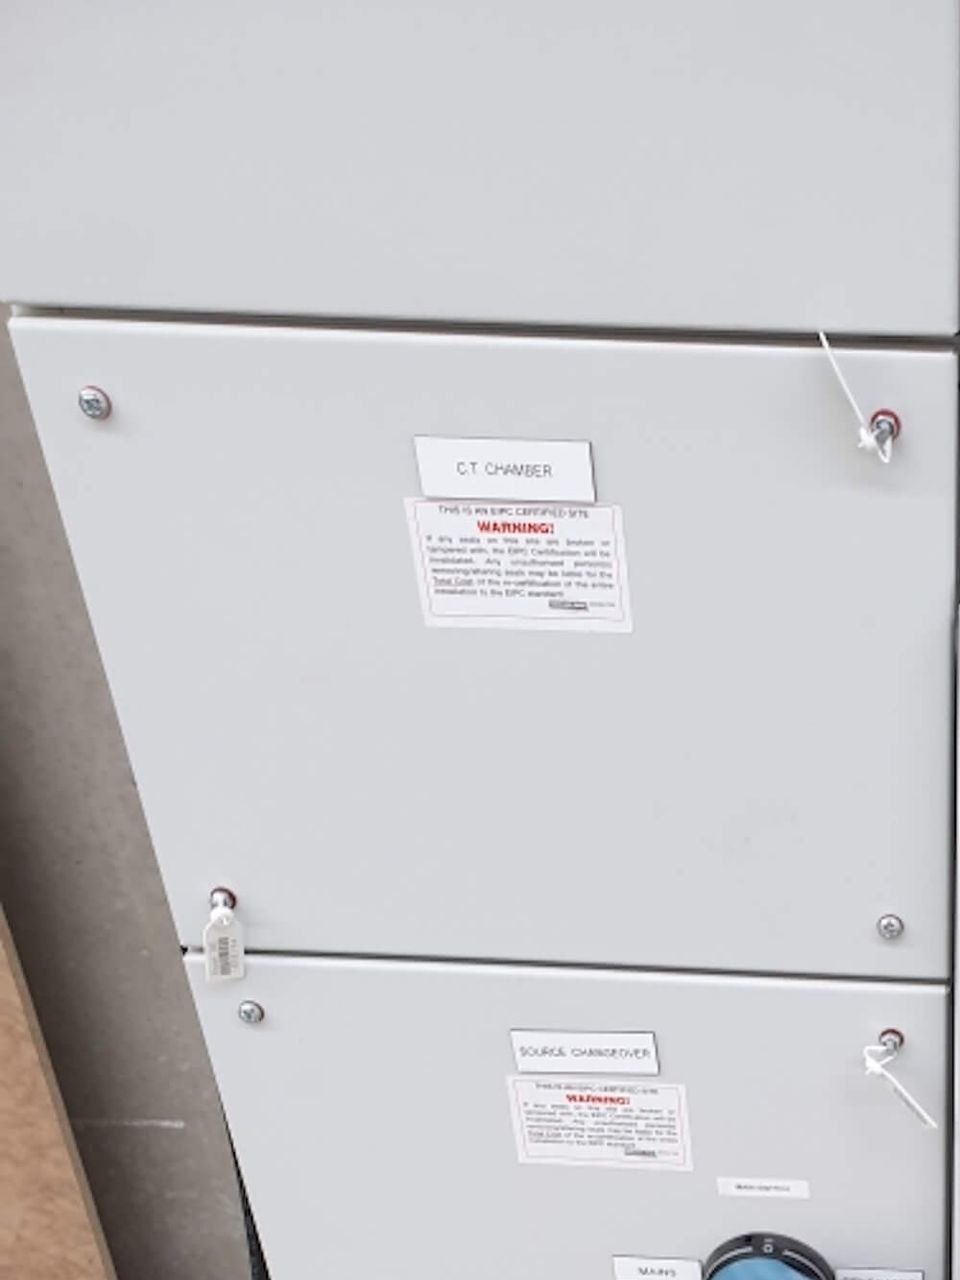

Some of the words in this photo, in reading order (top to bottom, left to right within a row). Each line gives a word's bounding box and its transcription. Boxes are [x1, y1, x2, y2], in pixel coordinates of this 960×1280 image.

[485, 461, 552, 478] CHAMBER
[477, 520, 554, 534] WARNING!
[519, 1046, 567, 1058] SOURCE
[571, 1047, 652, 1061] CHANGEOVER
[637, 1266, 677, 1280] MAINS
